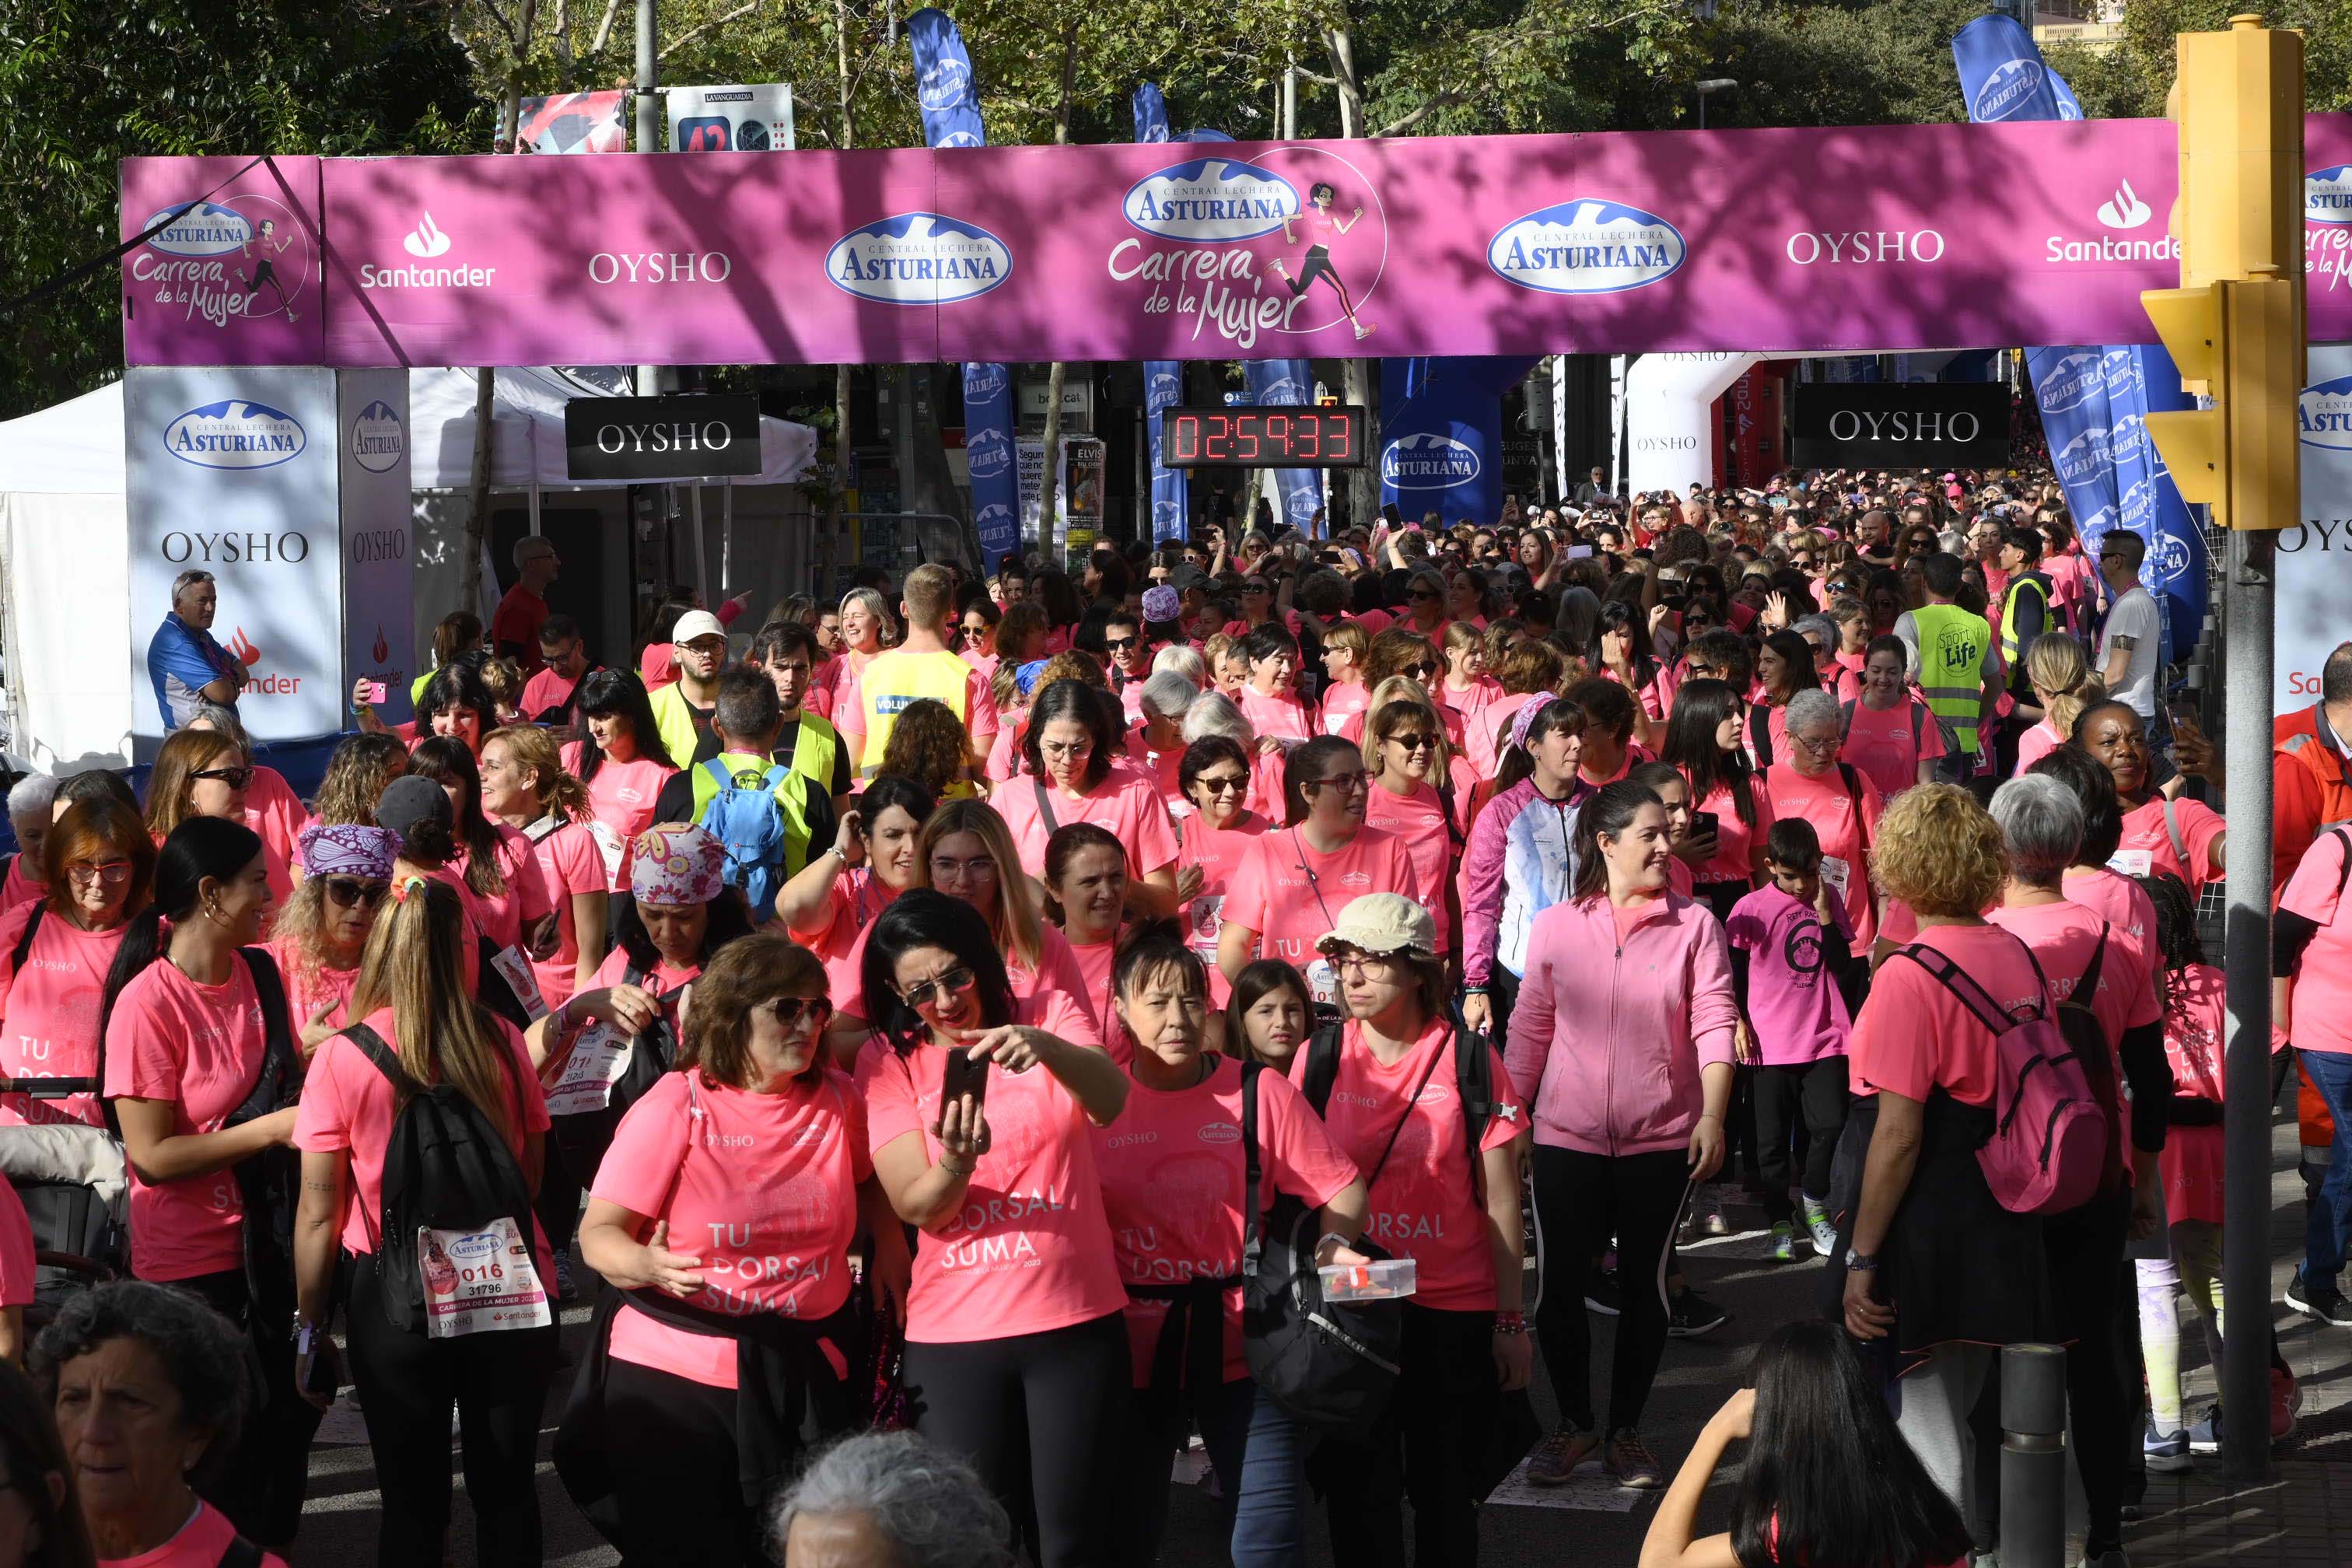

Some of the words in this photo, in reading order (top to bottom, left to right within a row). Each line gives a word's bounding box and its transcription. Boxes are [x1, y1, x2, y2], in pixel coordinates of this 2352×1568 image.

[714, 92, 753, 101] VANGUARDIA
[1164, 186, 1219, 195] CENTRAL
[1224, 185, 1281, 194] LECHERA
[1136, 189, 1285, 222] ASTURIANA
[1533, 231, 1594, 243] CENTRAL
[1601, 230, 1664, 240] LECHERA
[1787, 229, 1944, 265] OYSHO
[868, 243, 927, 254] CENTRAL
[1108, 237, 1253, 282] Carrera
[1503, 235, 1671, 271] ASTURIANA
[2046, 235, 2181, 262] Santande
[132, 252, 224, 282] Carrera
[360, 263, 495, 288] Santander
[588, 252, 732, 284] OYSHO
[839, 247, 998, 282] ASTURIANA
[156, 283, 172, 303] de
[177, 283, 188, 303] la
[187, 278, 258, 327] Mujer
[1143, 284, 1170, 314] de
[1176, 282, 1196, 313] la
[1192, 277, 1308, 349] Mujer
[196, 423, 242, 432] CENTRAL
[246, 423, 292, 432] LECHERA
[597, 421, 732, 453] OYSHO
[1176, 415, 1349, 458] 02:59:33
[1829, 410, 1980, 443] OYSHO
[175, 425, 296, 453] ASTURIANA
[355, 429, 401, 455] ASTURIANA
[1636, 436, 1696, 452] OYSHO
[1077, 449, 1101, 458] ELVIS
[1020, 471, 1045, 481] quiere
[1384, 455, 1472, 478] ASTURIANA
[162, 531, 309, 565] OYSHO
[353, 528, 404, 565] OYSHO
[1939, 628, 1971, 649] Sport
[1945, 642, 1976, 668] Life
[240, 673, 301, 695] nder
[2289, 672, 2322, 695] Sa
[877, 699, 910, 710] VOLUN
[1779, 798, 1810, 807] OYSHO
[1367, 817, 1399, 827] OYSHO
[1275, 937, 1301, 957] TU
[33, 958, 76, 973] OYSHO
[19, 1034, 51, 1061] TU
[1336, 1090, 1377, 1108] OYSHO
[1411, 1090, 1447, 1102] STURIANA
[702, 1134, 754, 1147] OYSHO
[1108, 1131, 1157, 1149] OYSHO
[1201, 1129, 1240, 1139] ASTURIANA
[949, 1184, 1064, 1233] DORSAL
[707, 1223, 751, 1248] TU
[1366, 1213, 1444, 1239] RSAL
[453, 1240, 500, 1255] ASTURIANA
[941, 1230, 1037, 1269] SUMA
[1125, 1226, 1157, 1251] TU
[461, 1262, 504, 1283] 016
[1023, 1258, 1041, 1269] 2023
[468, 1283, 502, 1296] 31796
[703, 1283, 798, 1318] SUMA
[496, 1297, 519, 1306] MUJER
[438, 1316, 473, 1330] OYSHO
[504, 1310, 541, 1321] Santander
